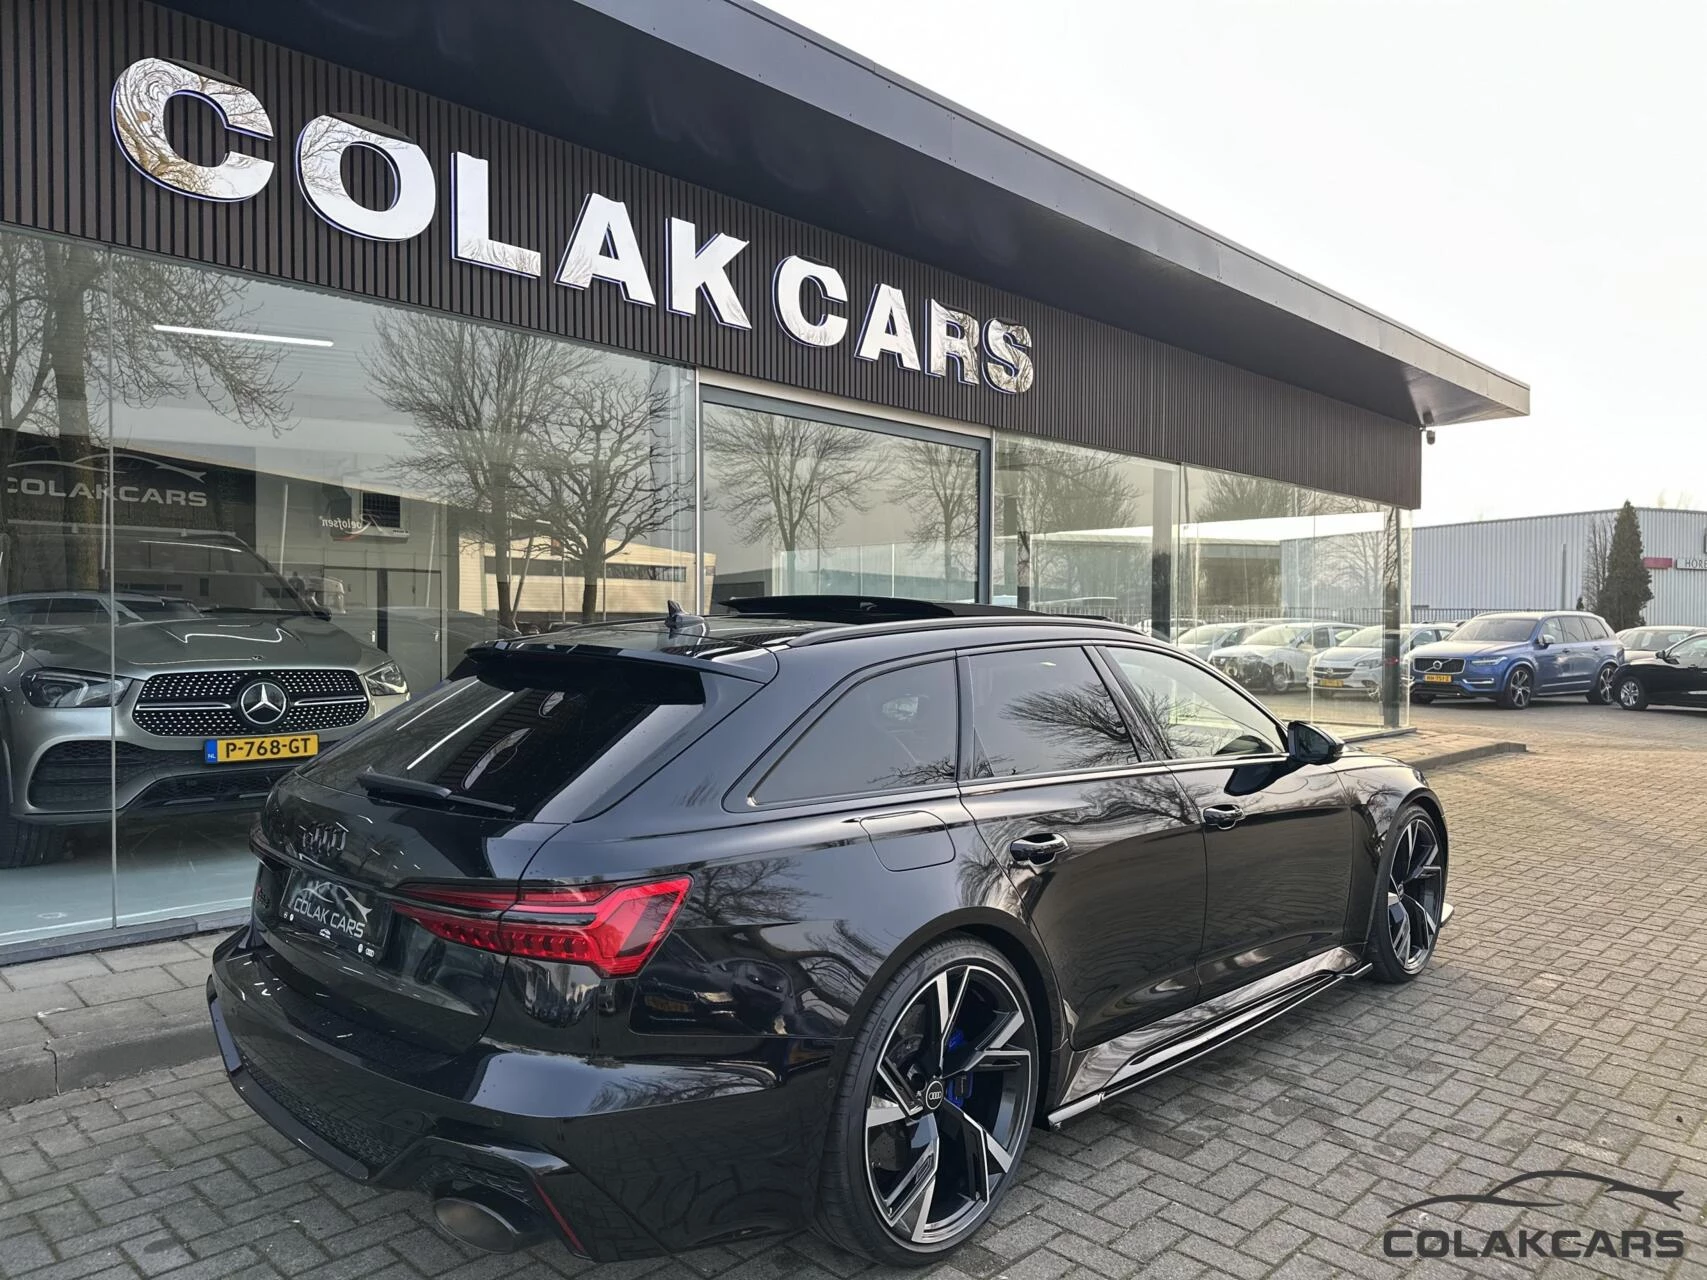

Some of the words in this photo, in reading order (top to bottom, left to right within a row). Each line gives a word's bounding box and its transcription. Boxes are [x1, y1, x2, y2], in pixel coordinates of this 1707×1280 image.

[111, 57, 752, 330] COLAK
[772, 254, 1034, 394] CARS
[226, 738, 311, 758] P-768-GT
[294, 898, 330, 924] COLAK
[330, 912, 366, 938] CARS
